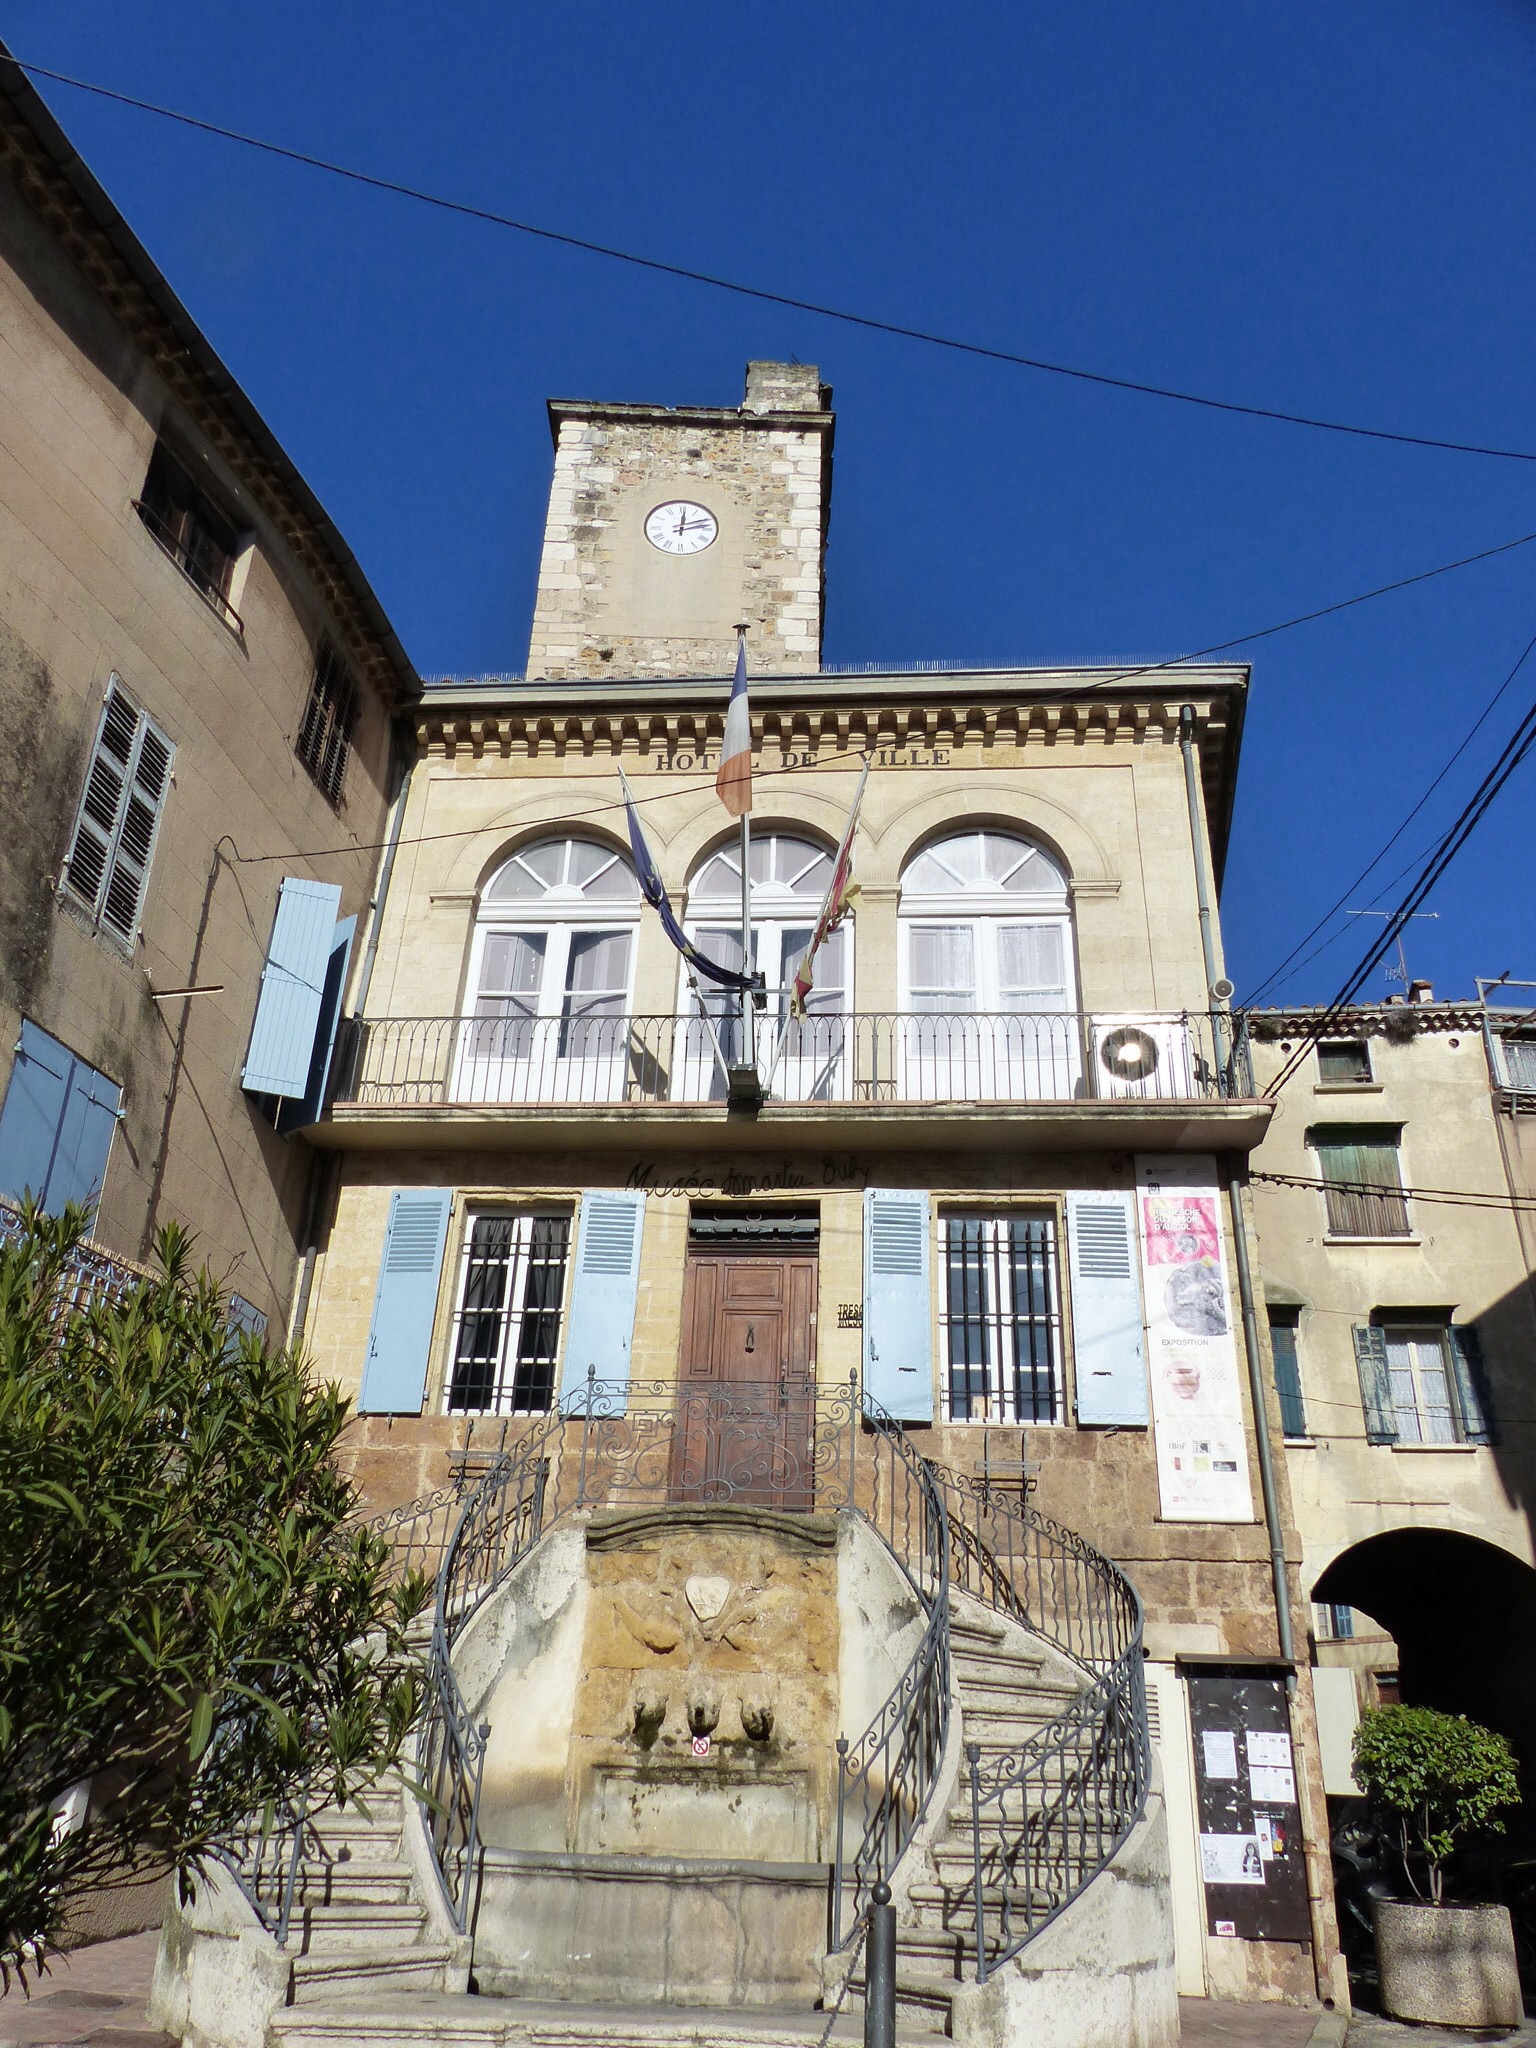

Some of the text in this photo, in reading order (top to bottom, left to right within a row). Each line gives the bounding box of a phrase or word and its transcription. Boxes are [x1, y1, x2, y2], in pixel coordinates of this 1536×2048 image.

[656, 749, 951, 771] HOT DE VILLE
[1154, 1208, 1201, 1217] RECHERCHE
[1154, 1216, 1165, 1224] DU
[1161, 1338, 1209, 1346] EXPOSITION
